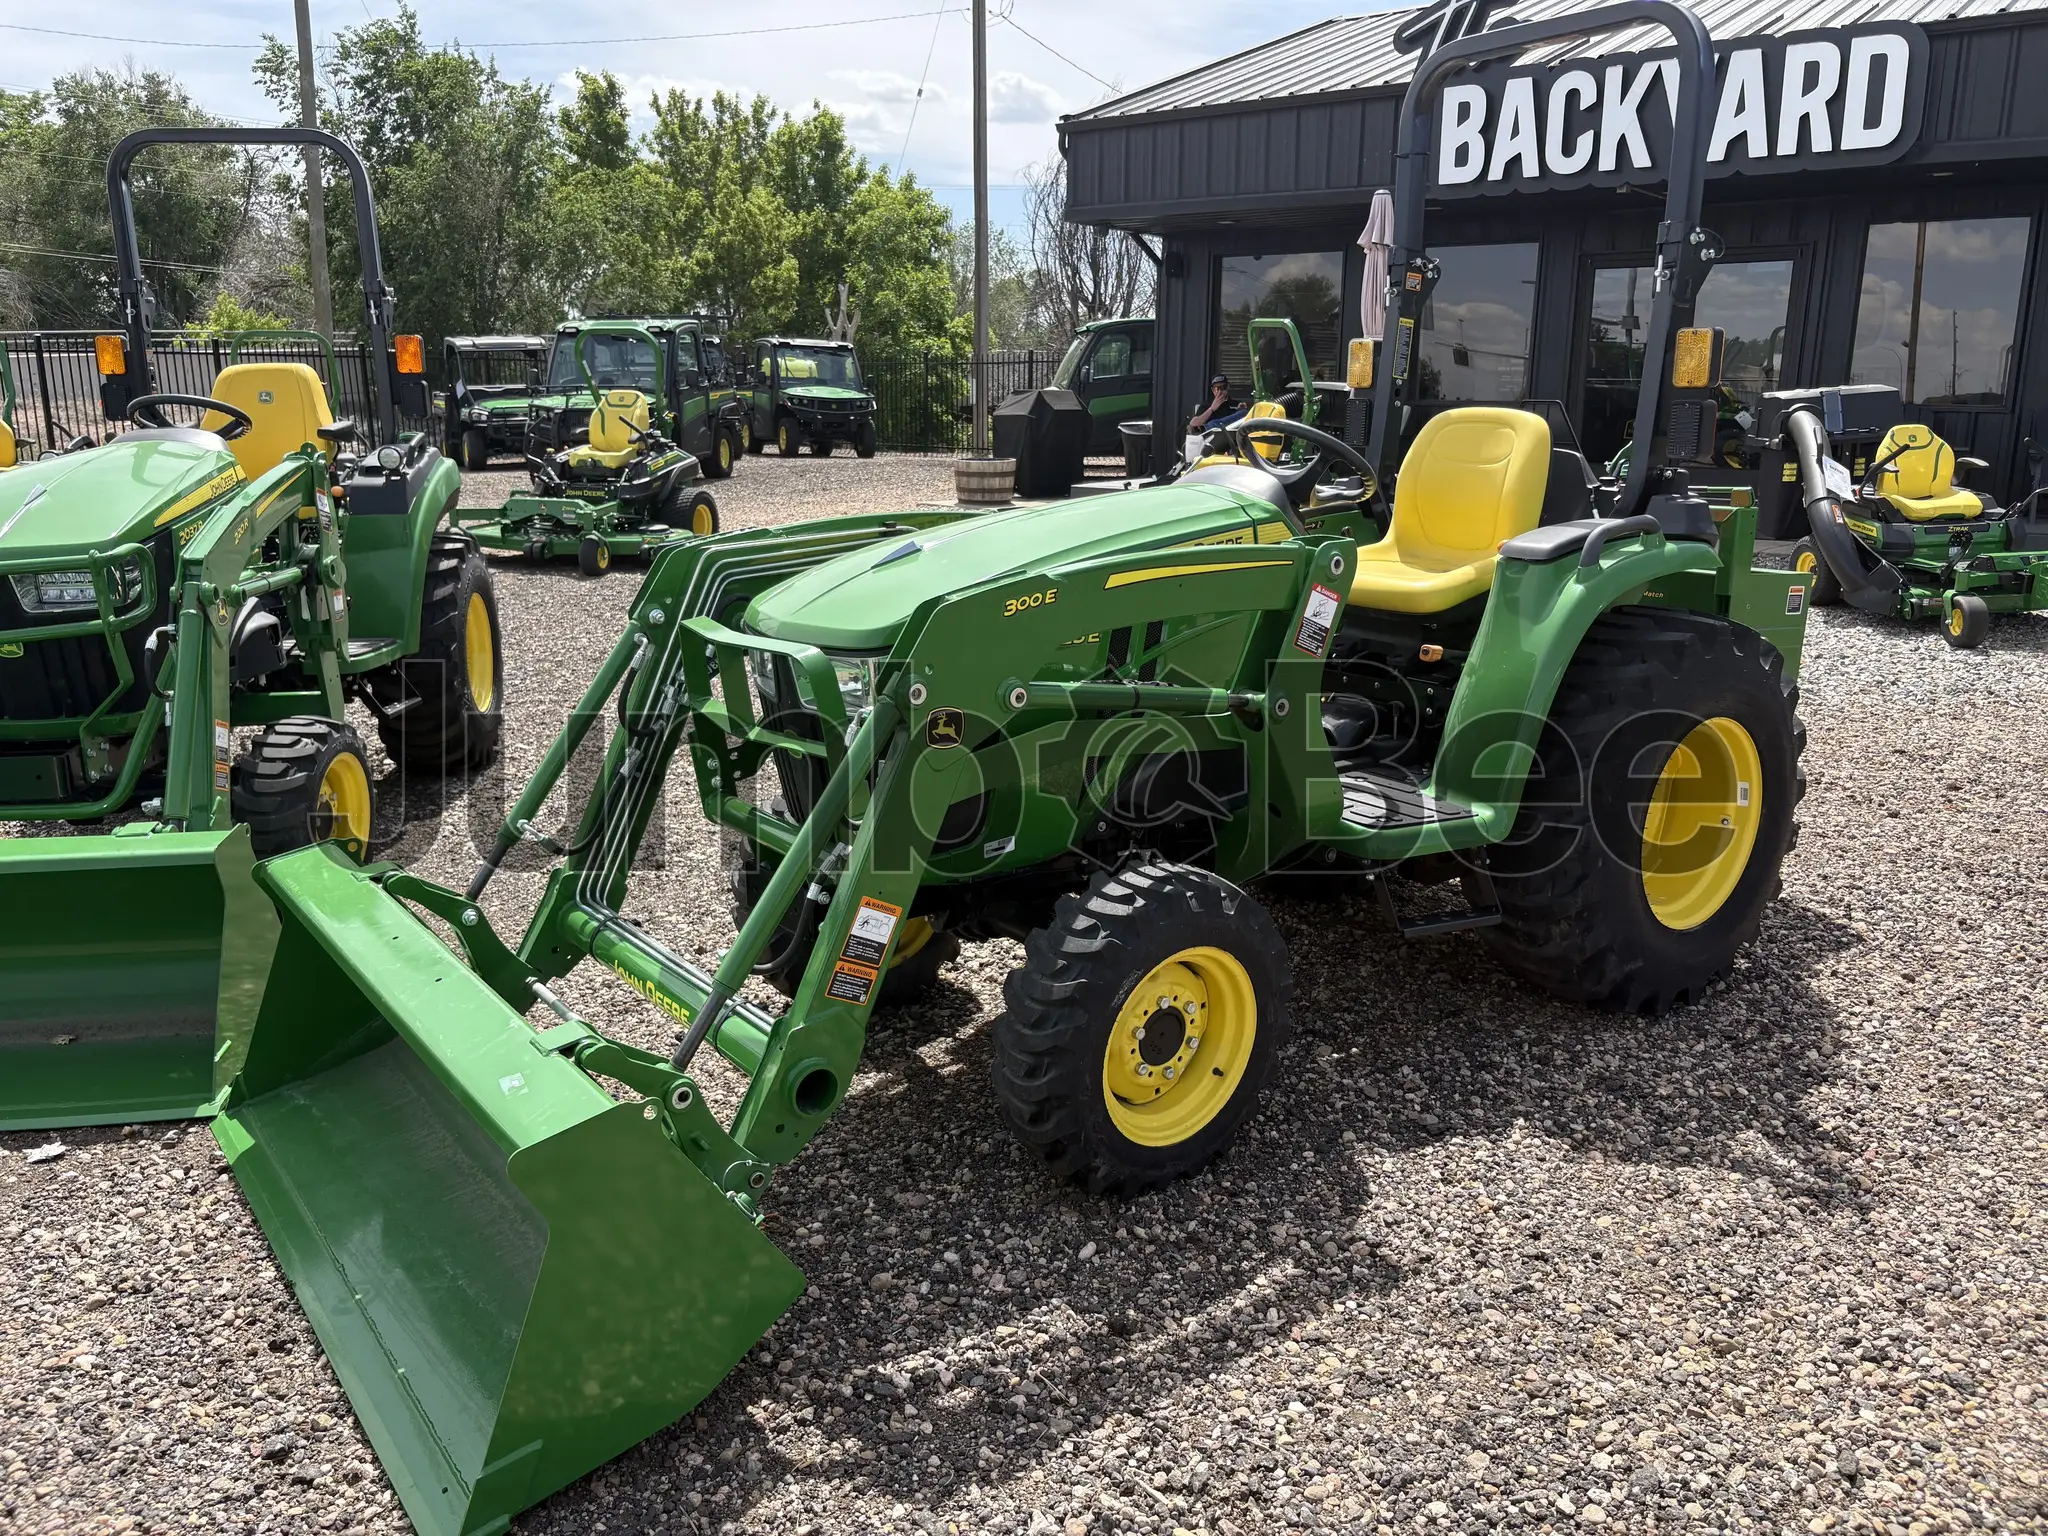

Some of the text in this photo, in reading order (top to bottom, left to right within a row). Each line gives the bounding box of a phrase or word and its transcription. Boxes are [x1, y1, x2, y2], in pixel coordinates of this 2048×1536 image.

[565, 489, 606, 497] JOHN DEERE
[1321, 588, 1338, 600] DANGER
[871, 902, 897, 914] WARNING
[847, 966, 873, 978] WARNING
